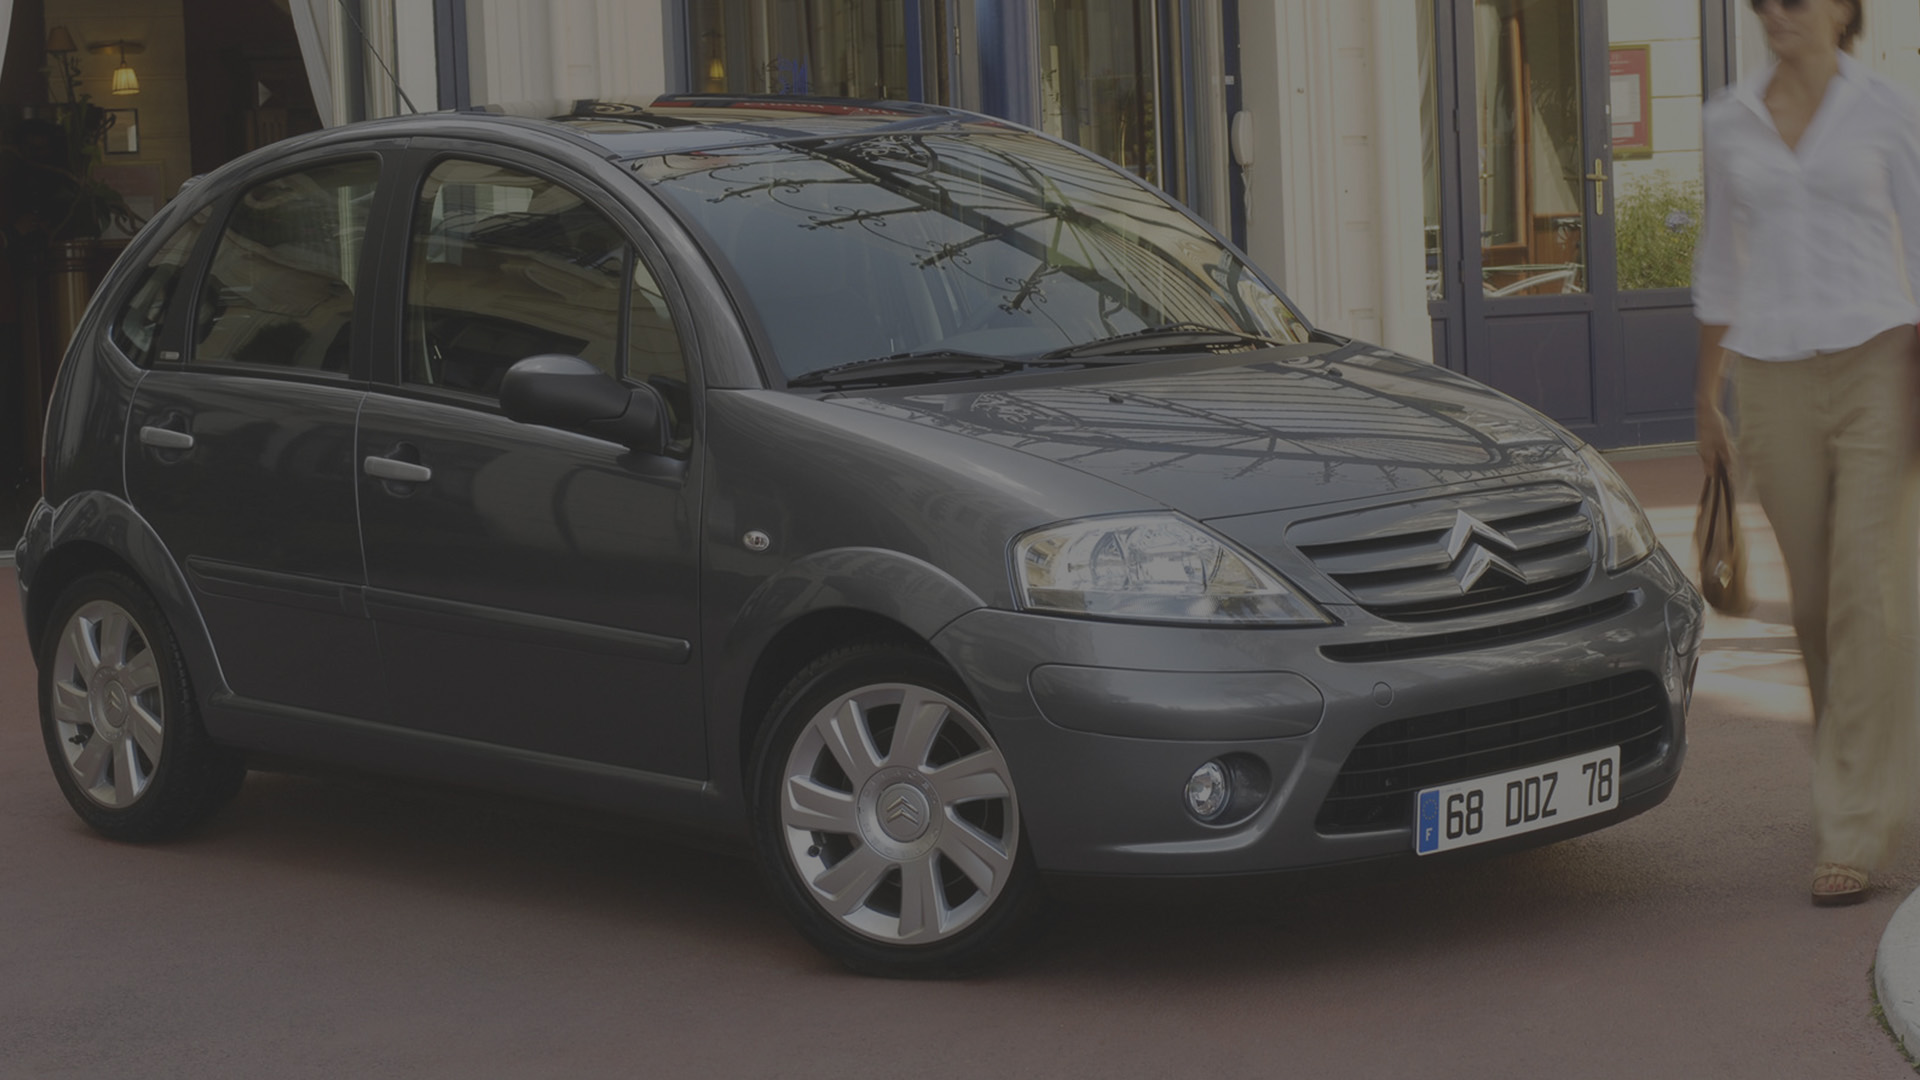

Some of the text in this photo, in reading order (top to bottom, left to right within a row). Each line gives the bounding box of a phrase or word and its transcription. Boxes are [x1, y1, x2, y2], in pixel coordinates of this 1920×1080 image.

[1446, 757, 1613, 840] 68 DDZ 78
[1425, 827, 1433, 842] F
